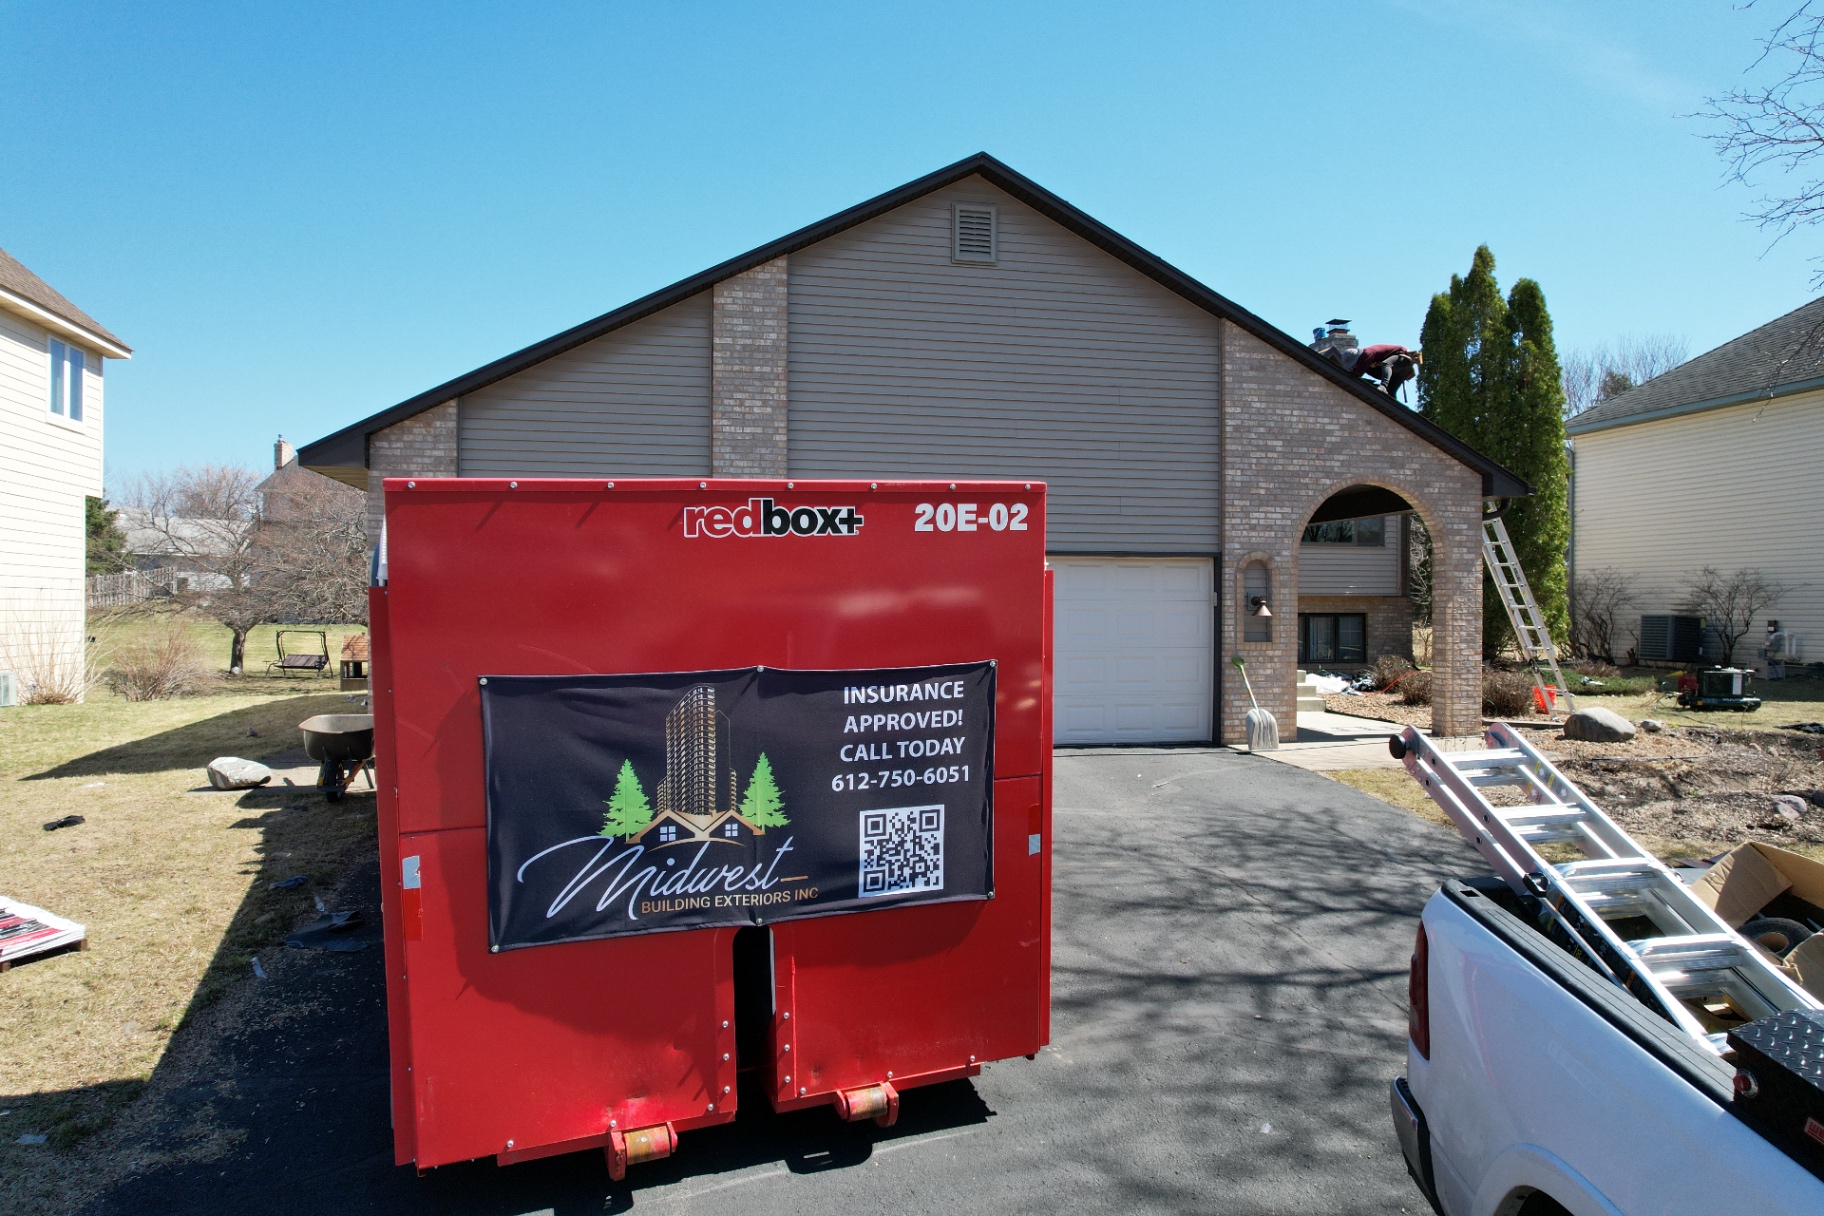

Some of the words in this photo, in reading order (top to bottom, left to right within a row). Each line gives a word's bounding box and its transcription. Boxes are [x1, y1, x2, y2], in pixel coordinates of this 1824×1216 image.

[914, 503, 1029, 532] 20E-02
[844, 681, 964, 704] INSURANCE
[843, 709, 963, 733] APPROVED!
[840, 742, 893, 762] CALL
[896, 736, 966, 758] TODAY
[831, 765, 969, 792] 612-750-6051
[517, 835, 794, 920] Midwest
[641, 896, 711, 914] BUILDING
[714, 890, 791, 908] EXTERIORS
[794, 886, 819, 900] INC
